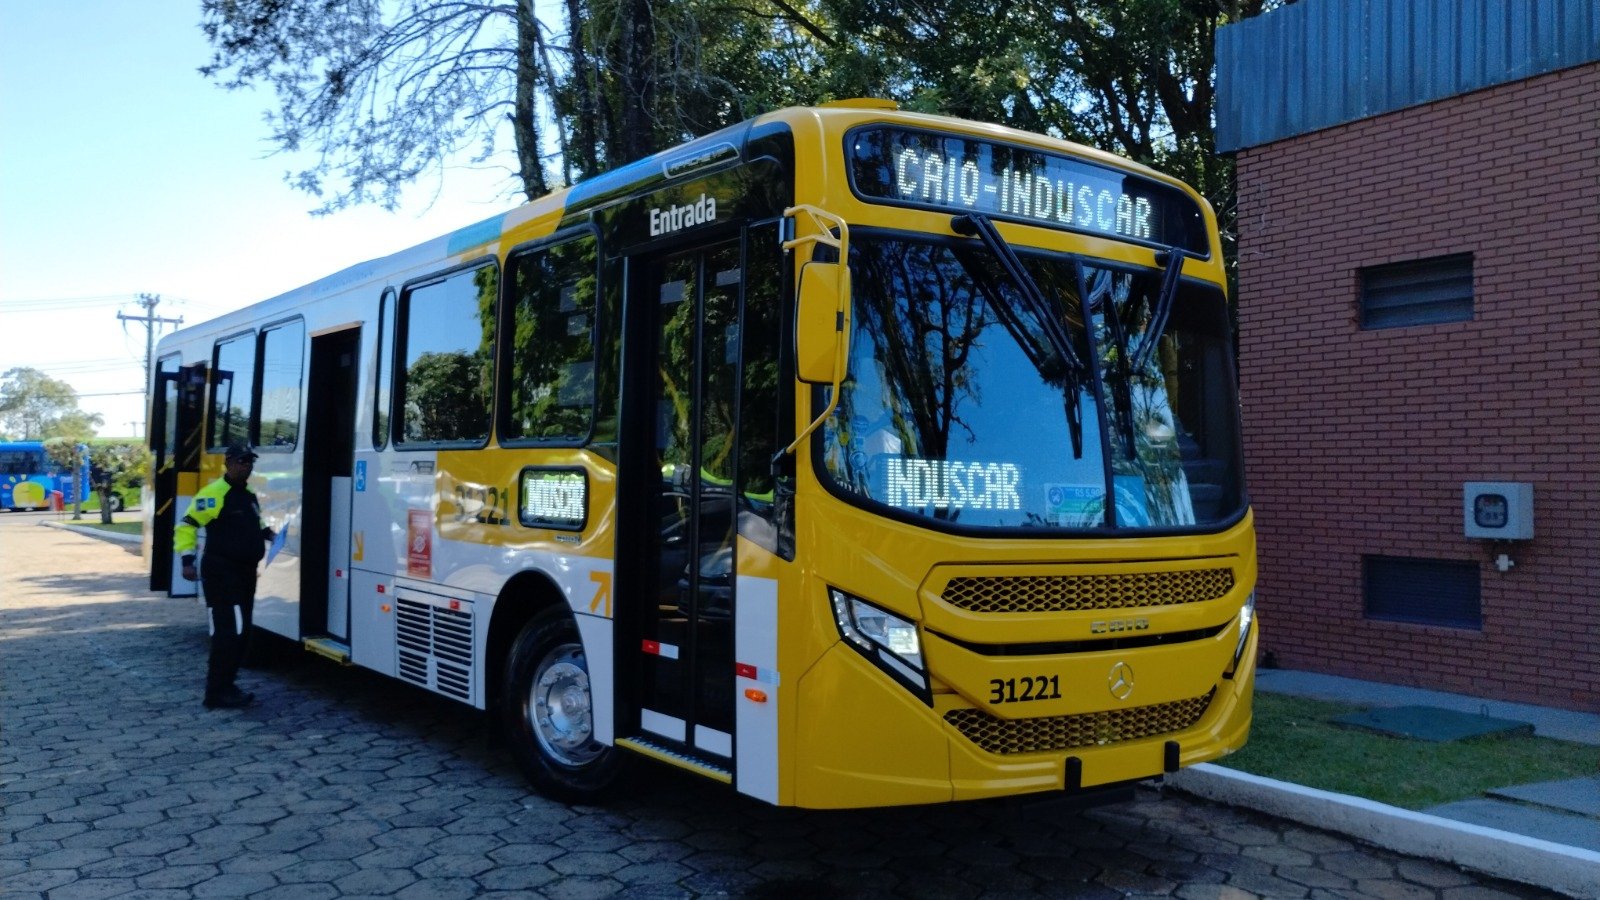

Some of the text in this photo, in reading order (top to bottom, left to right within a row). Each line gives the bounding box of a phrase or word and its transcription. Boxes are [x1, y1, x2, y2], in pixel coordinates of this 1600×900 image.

[650, 193, 716, 237] Entrada
[898, 148, 1151, 239] CAIO-INDUSCAR
[888, 458, 1021, 510] INDUSCAR
[989, 674, 1062, 704] 31221
